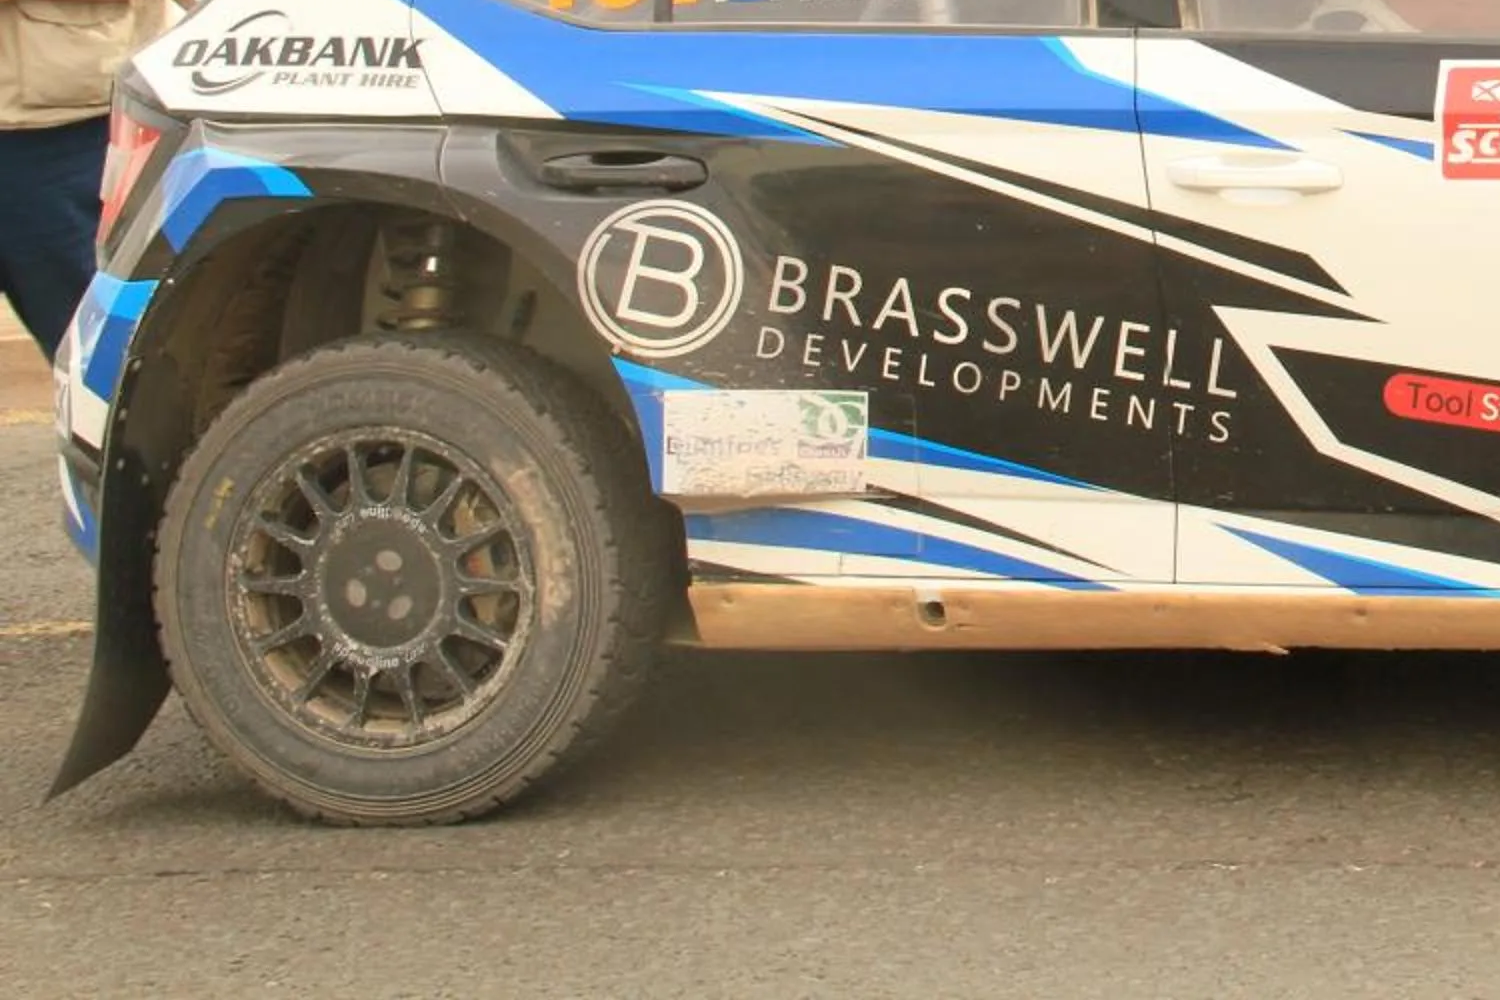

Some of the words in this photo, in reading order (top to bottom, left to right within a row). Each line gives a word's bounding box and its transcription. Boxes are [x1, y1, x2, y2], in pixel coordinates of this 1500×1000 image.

[172, 36, 425, 69] OAKBANK
[272, 72, 354, 88] PLANT
[359, 74, 420, 90] HIRE
[768, 255, 1239, 398] BRASSWELL
[755, 326, 1232, 443] DEVELOPMENTS
[1406, 382, 1473, 418] Tool
